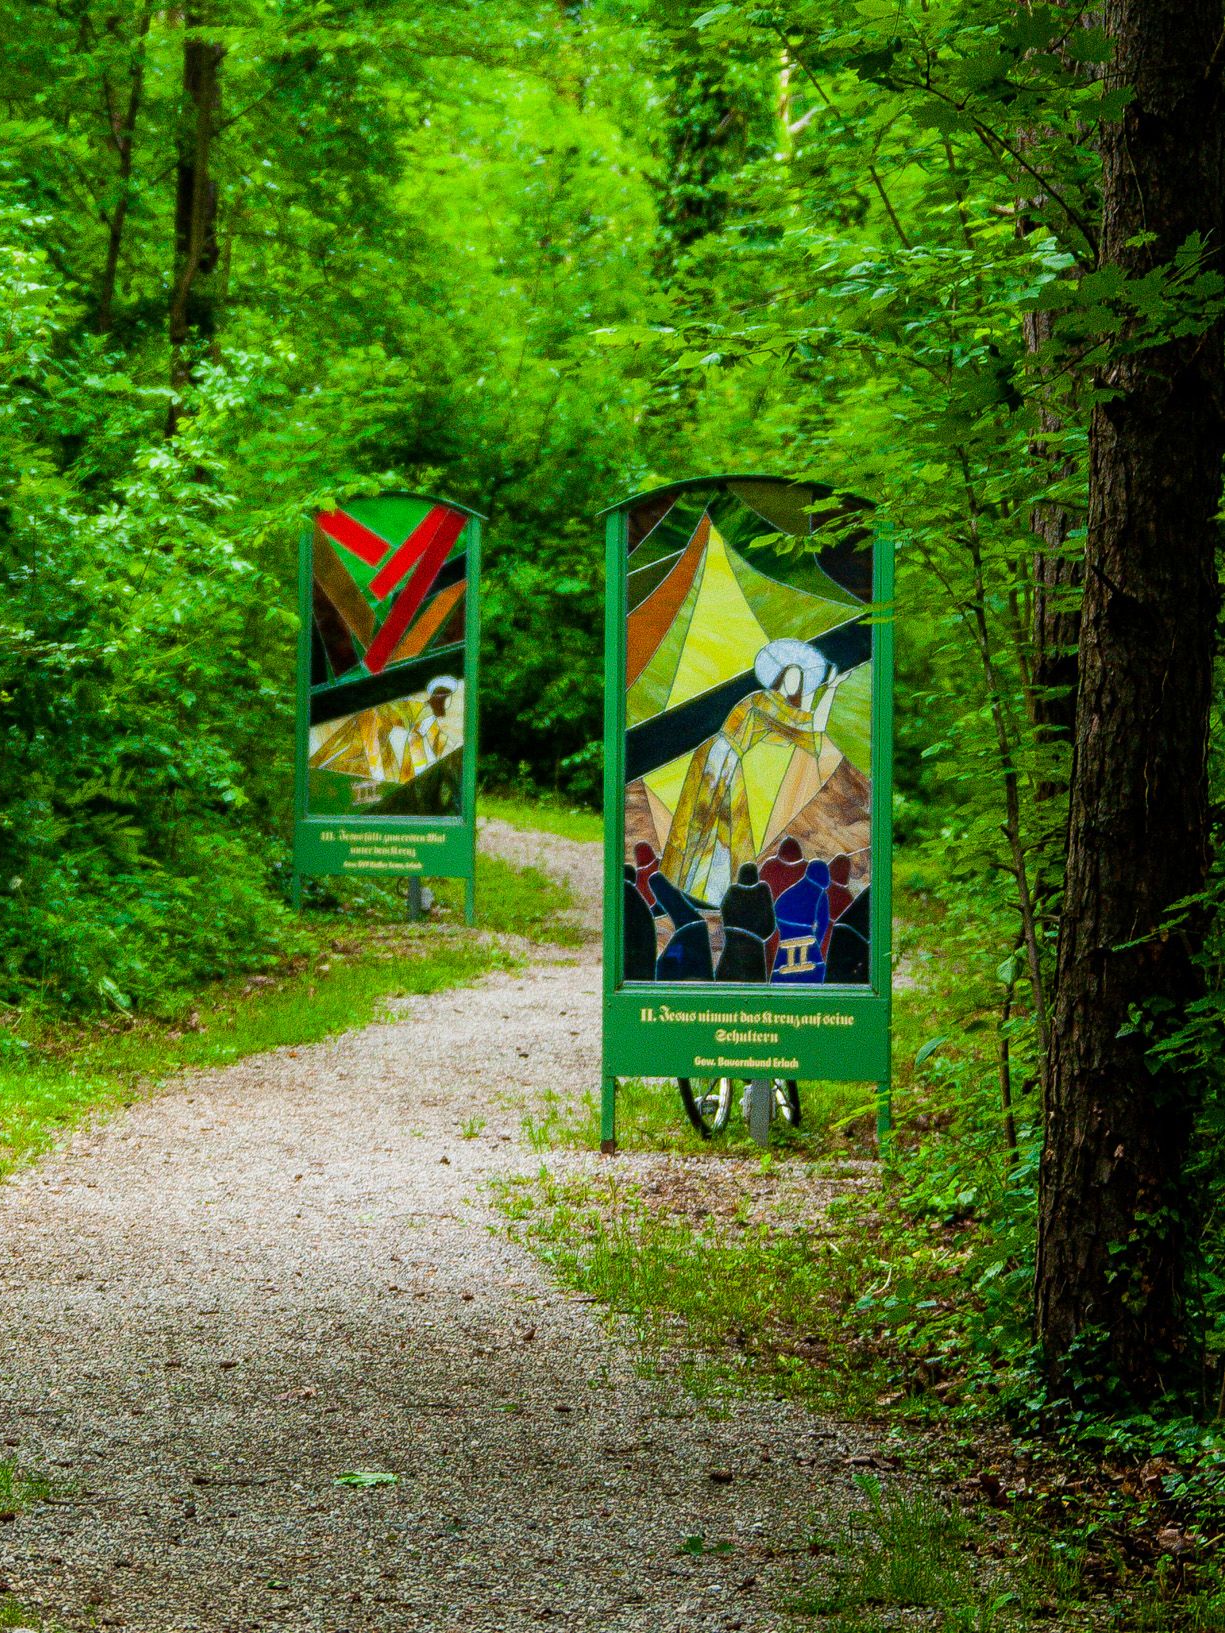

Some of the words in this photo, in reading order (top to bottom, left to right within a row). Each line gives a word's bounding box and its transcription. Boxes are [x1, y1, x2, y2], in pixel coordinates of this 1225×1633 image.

[640, 1008, 657, 1022] II.
[659, 1005, 697, 1023] Jesus
[698, 1010, 738, 1024] nimmt
[739, 1011, 761, 1024] das
[801, 1014, 822, 1029] auf
[822, 1014, 855, 1026] seine
[714, 1028, 779, 1045] Schultern
[694, 1056, 717, 1067] Gew.
[718, 1056, 772, 1069] Bauernbund
[773, 1057, 799, 1070] Erlach
